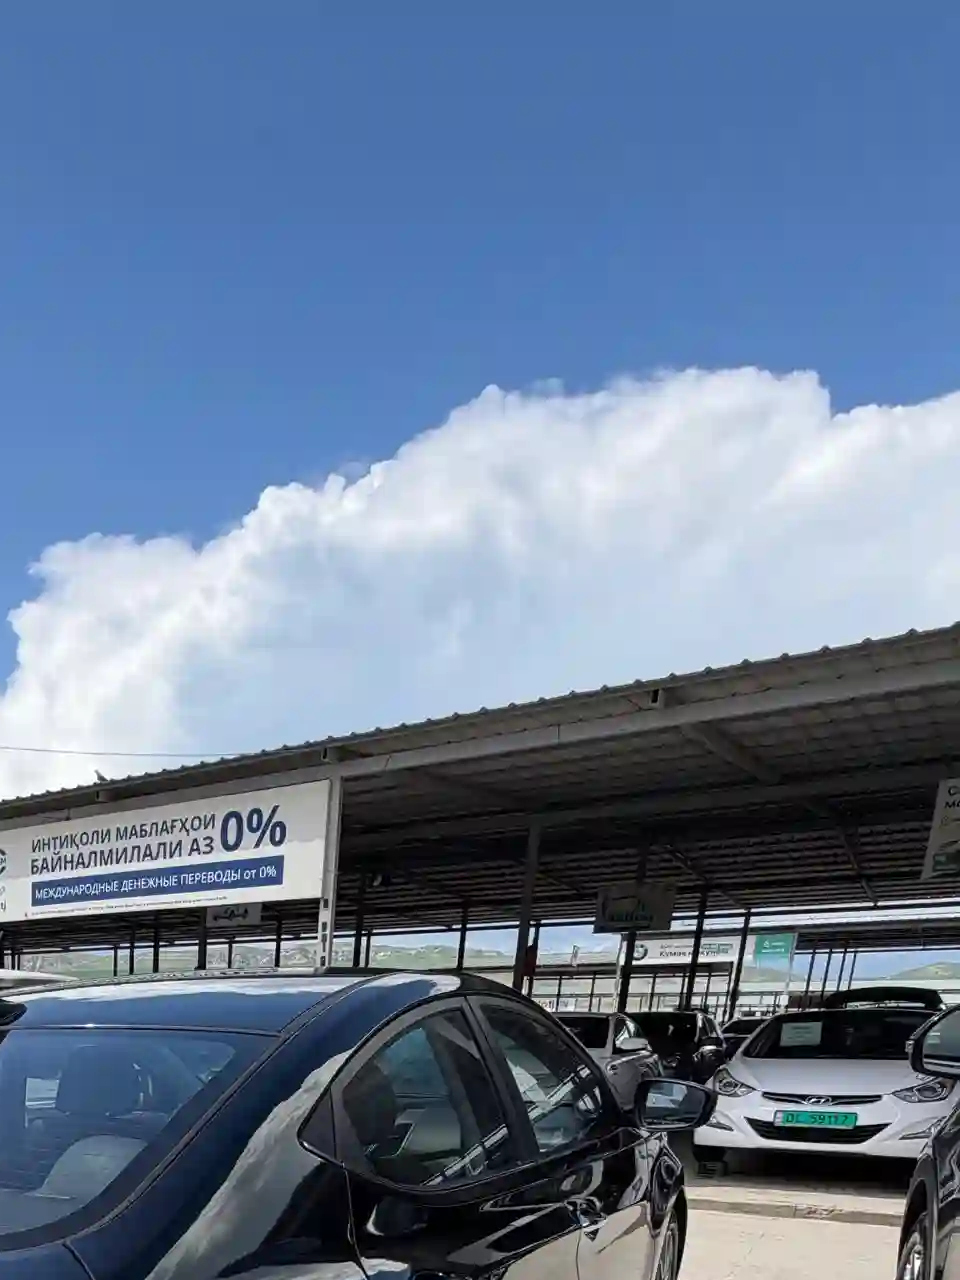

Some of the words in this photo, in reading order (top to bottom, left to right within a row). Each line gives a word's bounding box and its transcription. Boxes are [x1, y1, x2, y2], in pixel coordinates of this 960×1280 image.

[30, 839, 183, 876] БАЙНАЛМИЛАЛИ
[187, 836, 215, 857] АЗ
[220, 804, 287, 852] 0%
[31, 828, 111, 853] ИНТИҚОЛИ
[116, 813, 216, 842] МАБЛАҒҲОИ
[35, 880, 119, 900] МЕЖДУНАРОДНЫЕ
[121, 875, 178, 893] ДЕНЕЖНЫЕ
[180, 869, 241, 885] ПЕРЕВОДЫ
[243, 870, 257, 880] от
[259, 865, 277, 879] 0%
